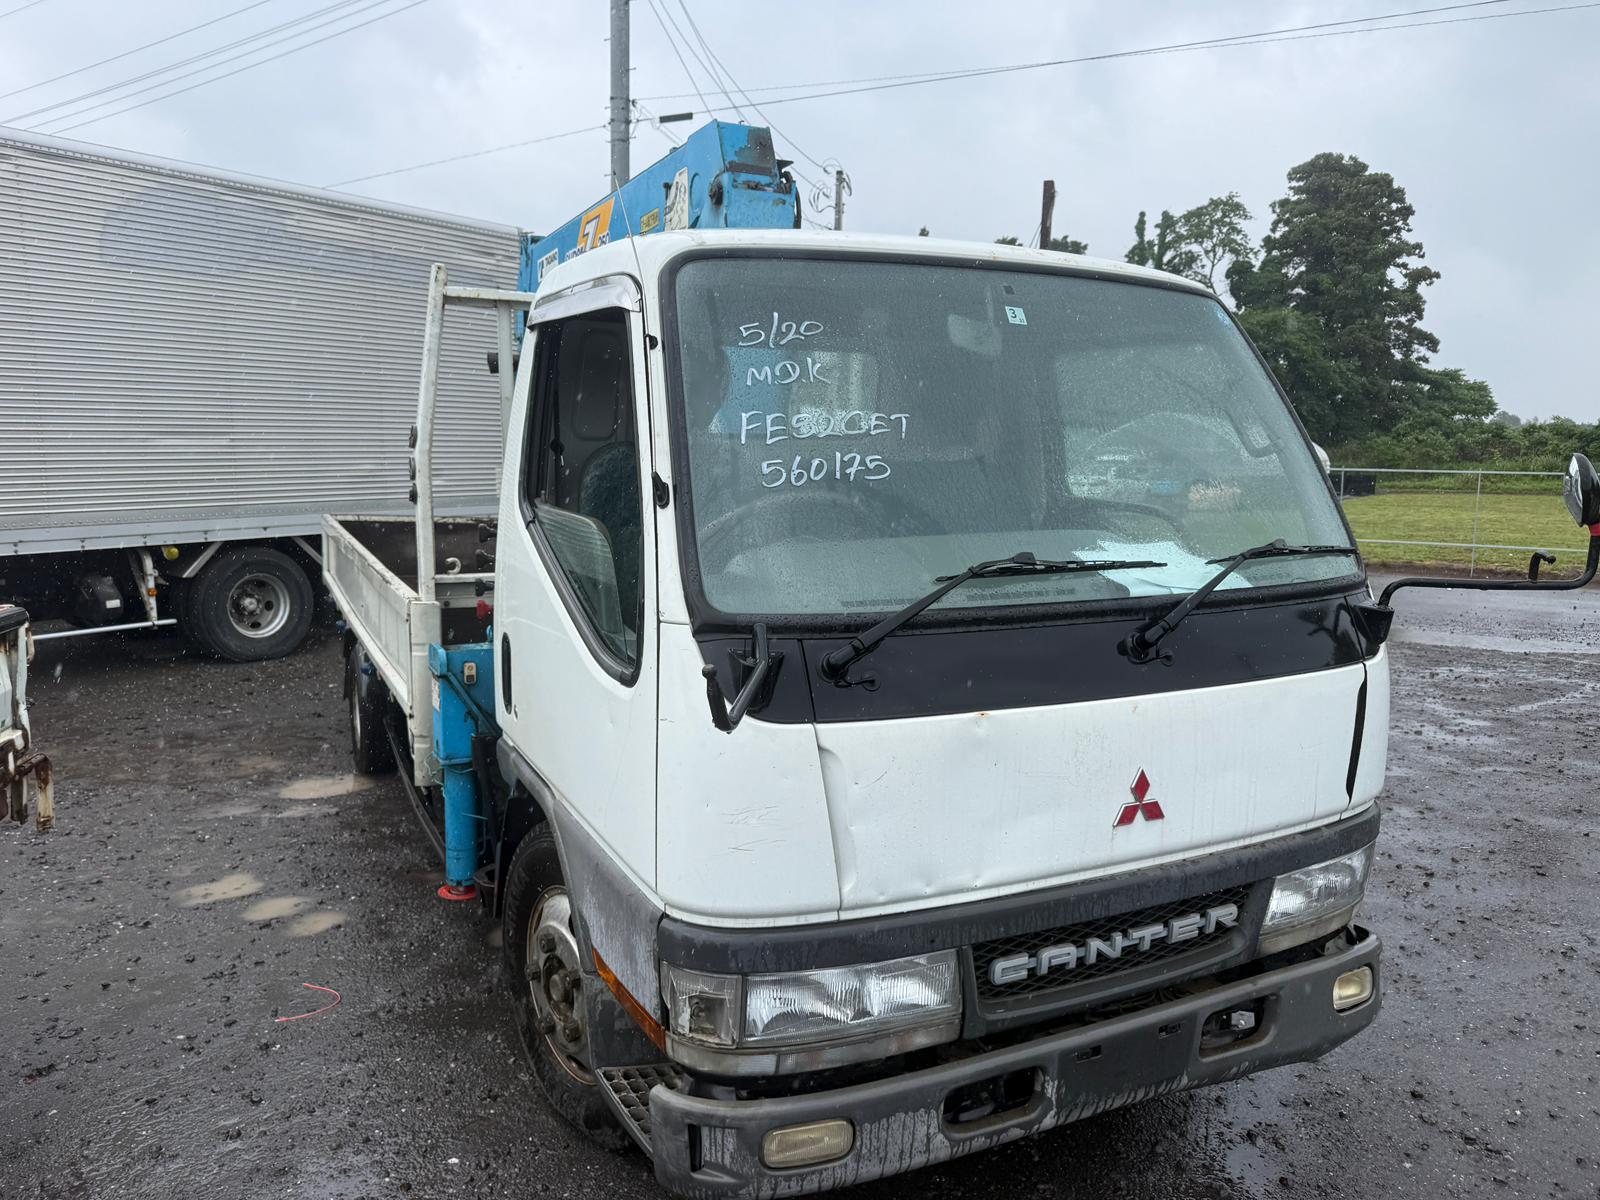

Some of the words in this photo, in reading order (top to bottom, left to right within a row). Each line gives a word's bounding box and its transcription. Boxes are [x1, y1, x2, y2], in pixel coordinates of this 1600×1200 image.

[738, 312, 824, 348] 5/20
[1009, 308, 1017, 319] 3
[761, 451, 892, 488] 560175
[988, 903, 1240, 986] CANTER
